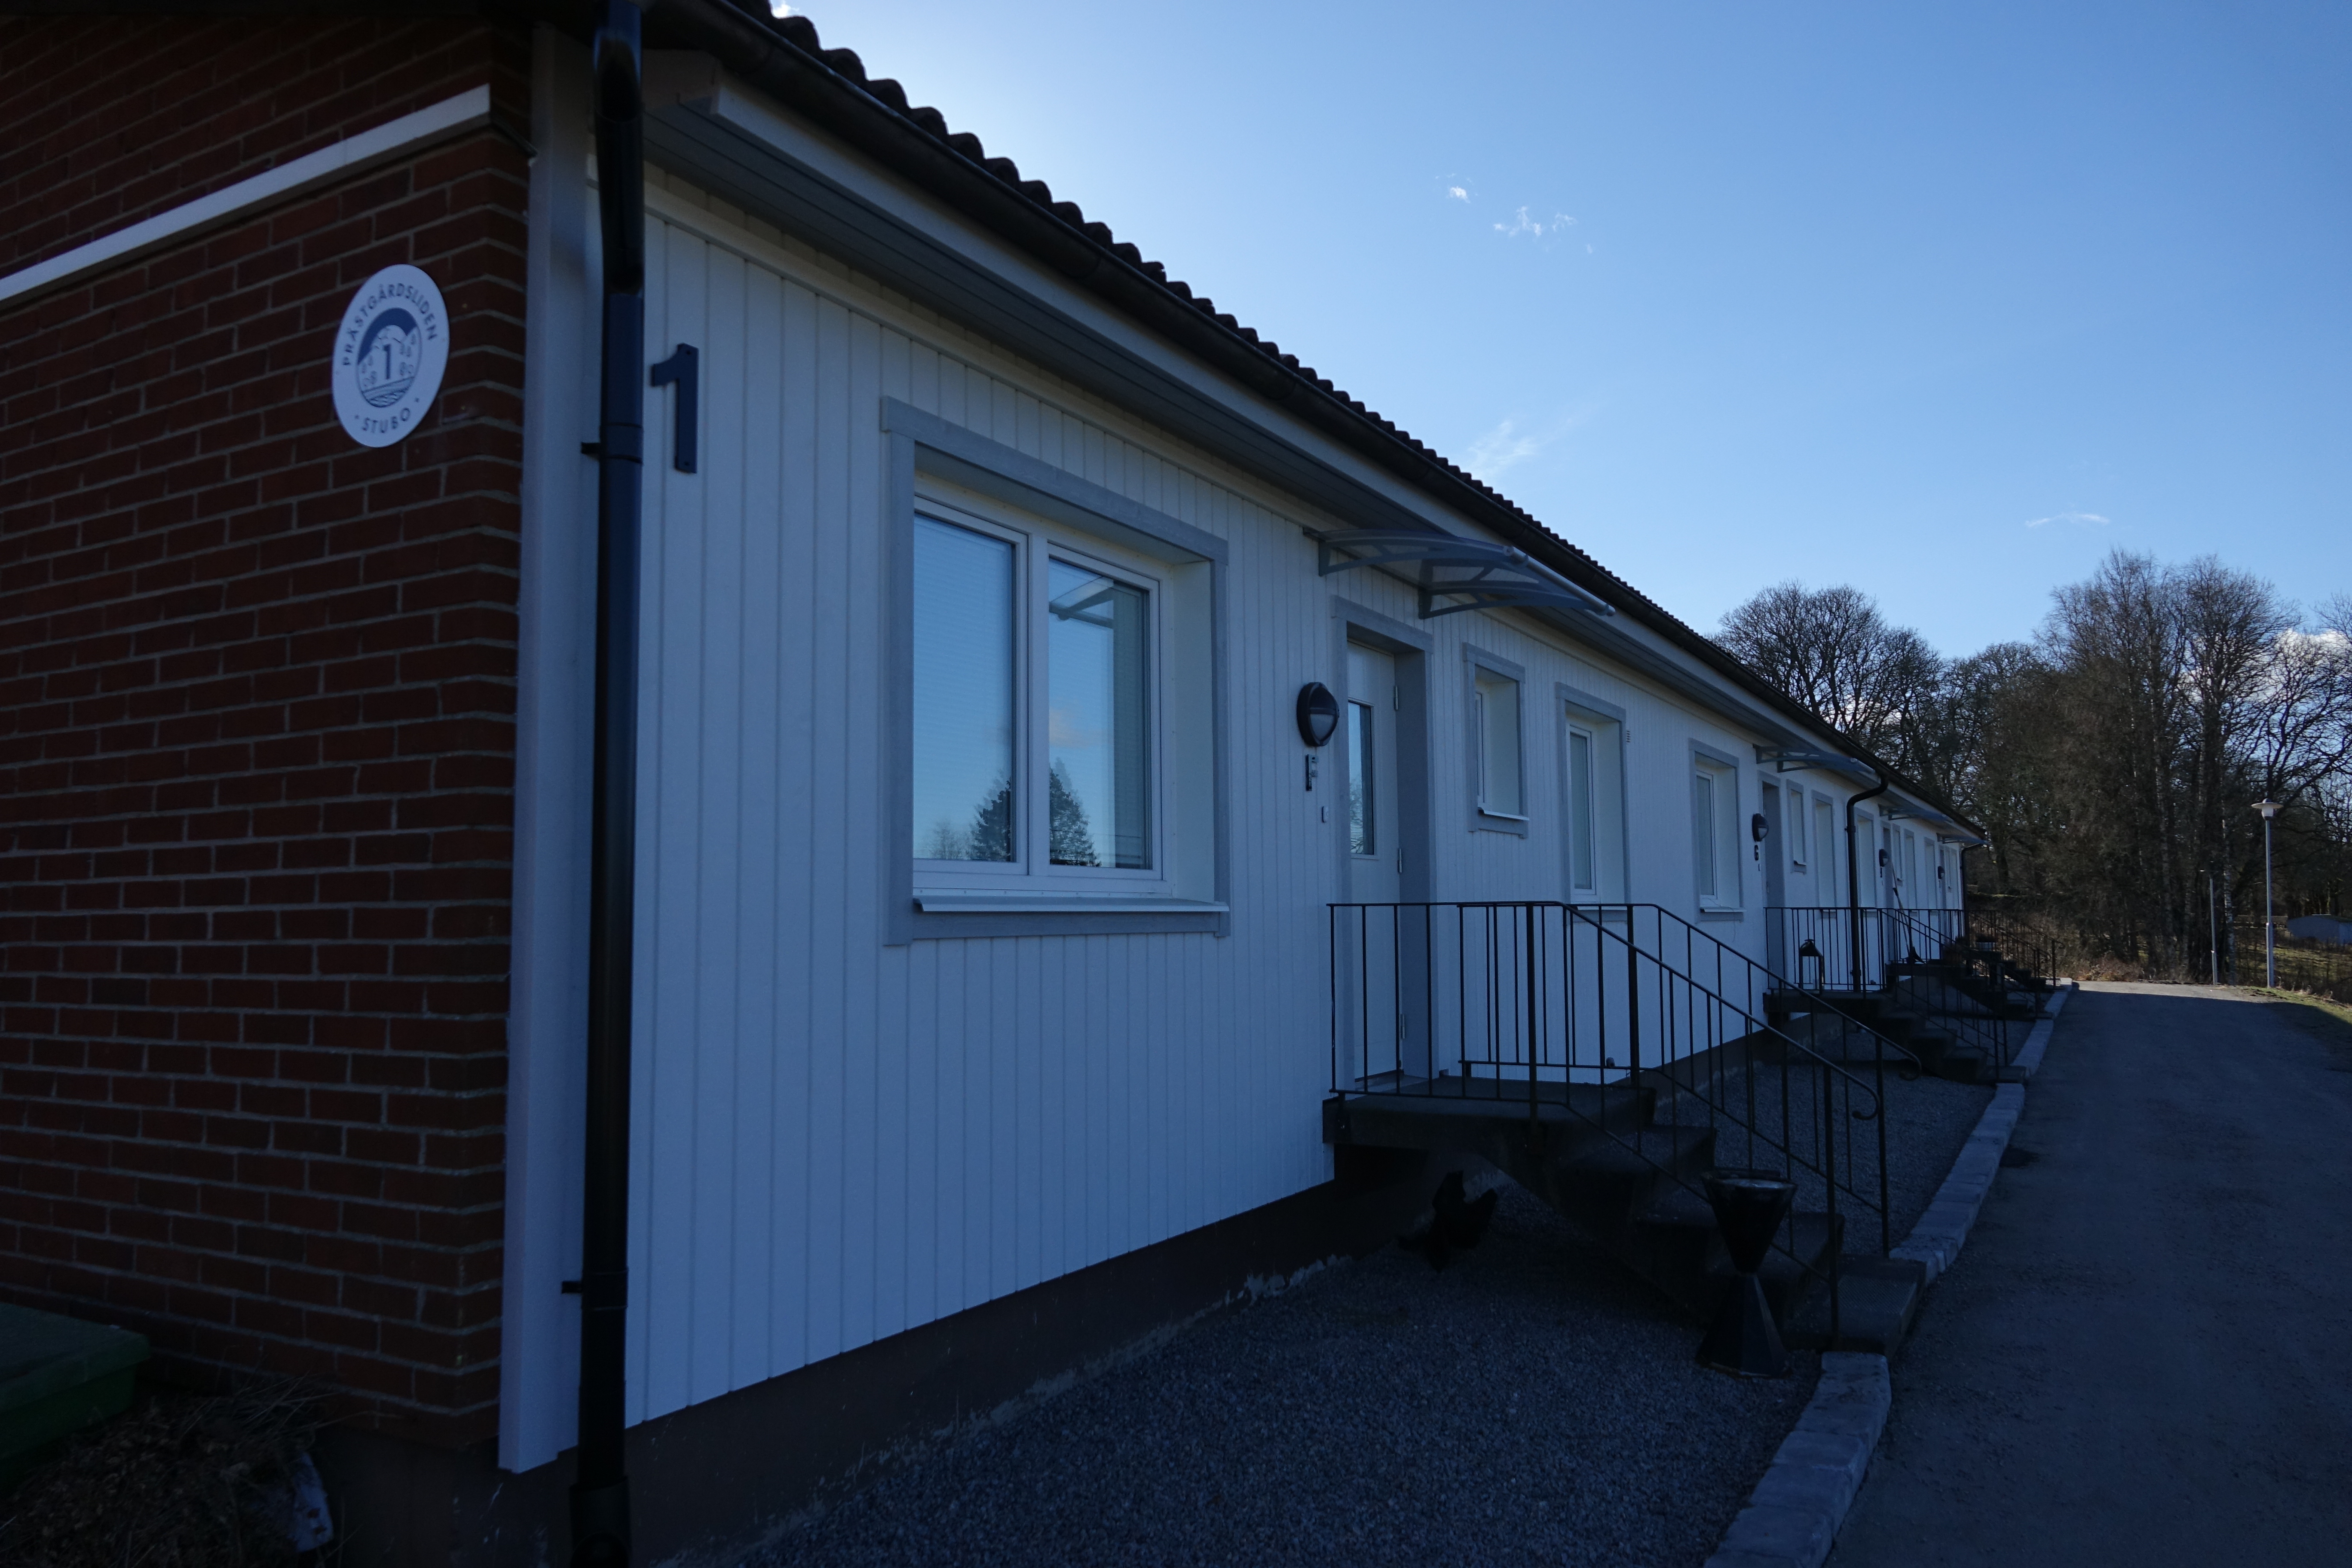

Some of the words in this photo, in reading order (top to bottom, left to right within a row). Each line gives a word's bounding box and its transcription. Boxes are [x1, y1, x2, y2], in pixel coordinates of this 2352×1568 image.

[383, 344, 391, 380] 1
[361, 407, 411, 434] STUBO
[651, 343, 699, 474] 1
